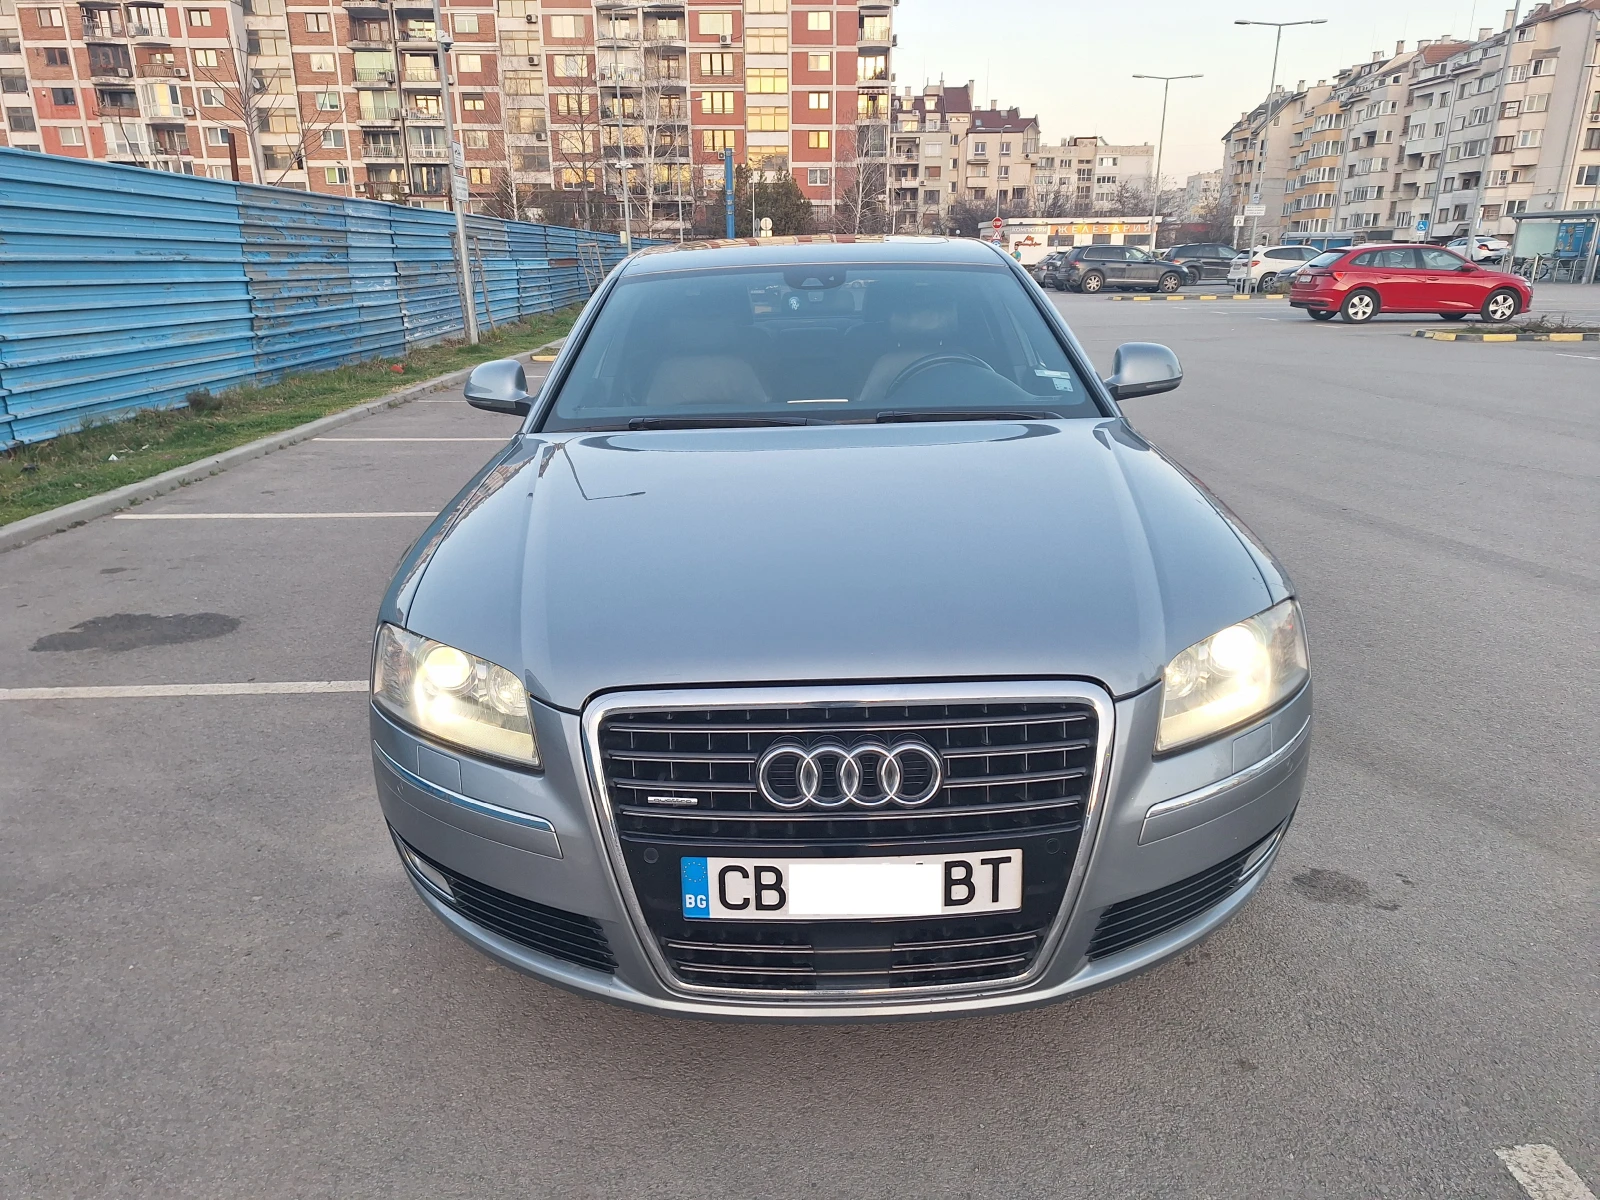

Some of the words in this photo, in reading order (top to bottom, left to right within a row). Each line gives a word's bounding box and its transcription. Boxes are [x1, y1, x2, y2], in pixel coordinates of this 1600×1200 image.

[1058, 224, 1151, 234] ЖЕЛЕЗАРИЯ
[718, 865, 787, 911] CB
[944, 856, 1012, 907] BT
[685, 894, 707, 909] BG
